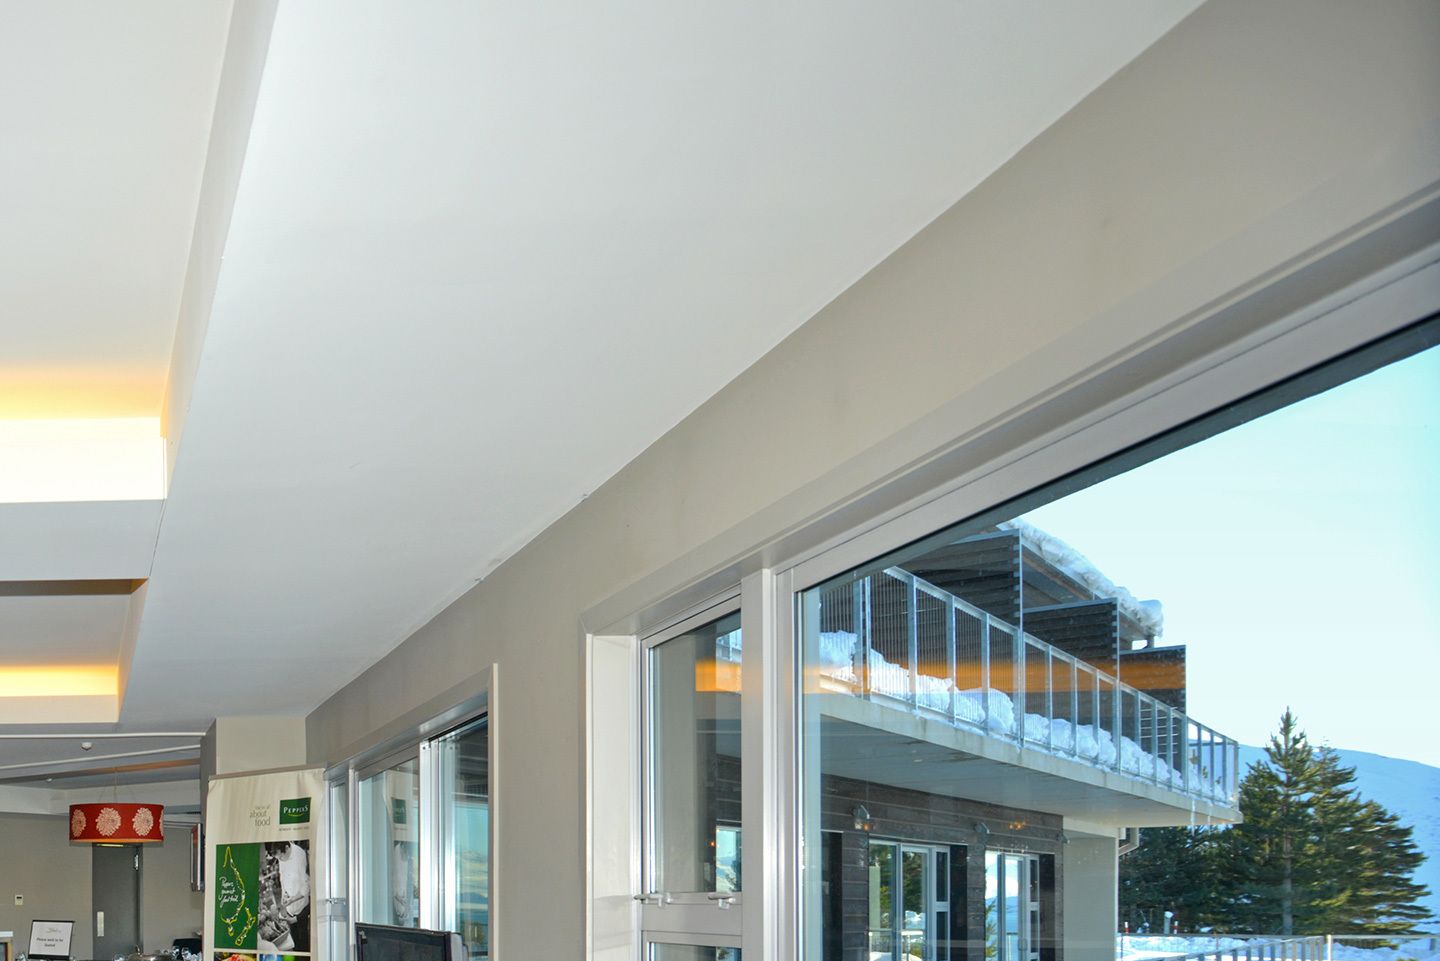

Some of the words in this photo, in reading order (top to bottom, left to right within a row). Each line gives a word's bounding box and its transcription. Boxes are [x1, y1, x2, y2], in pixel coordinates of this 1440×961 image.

[283, 805, 308, 814] PEPPERS
[250, 810, 267, 819] about
[255, 816, 270, 826] food
